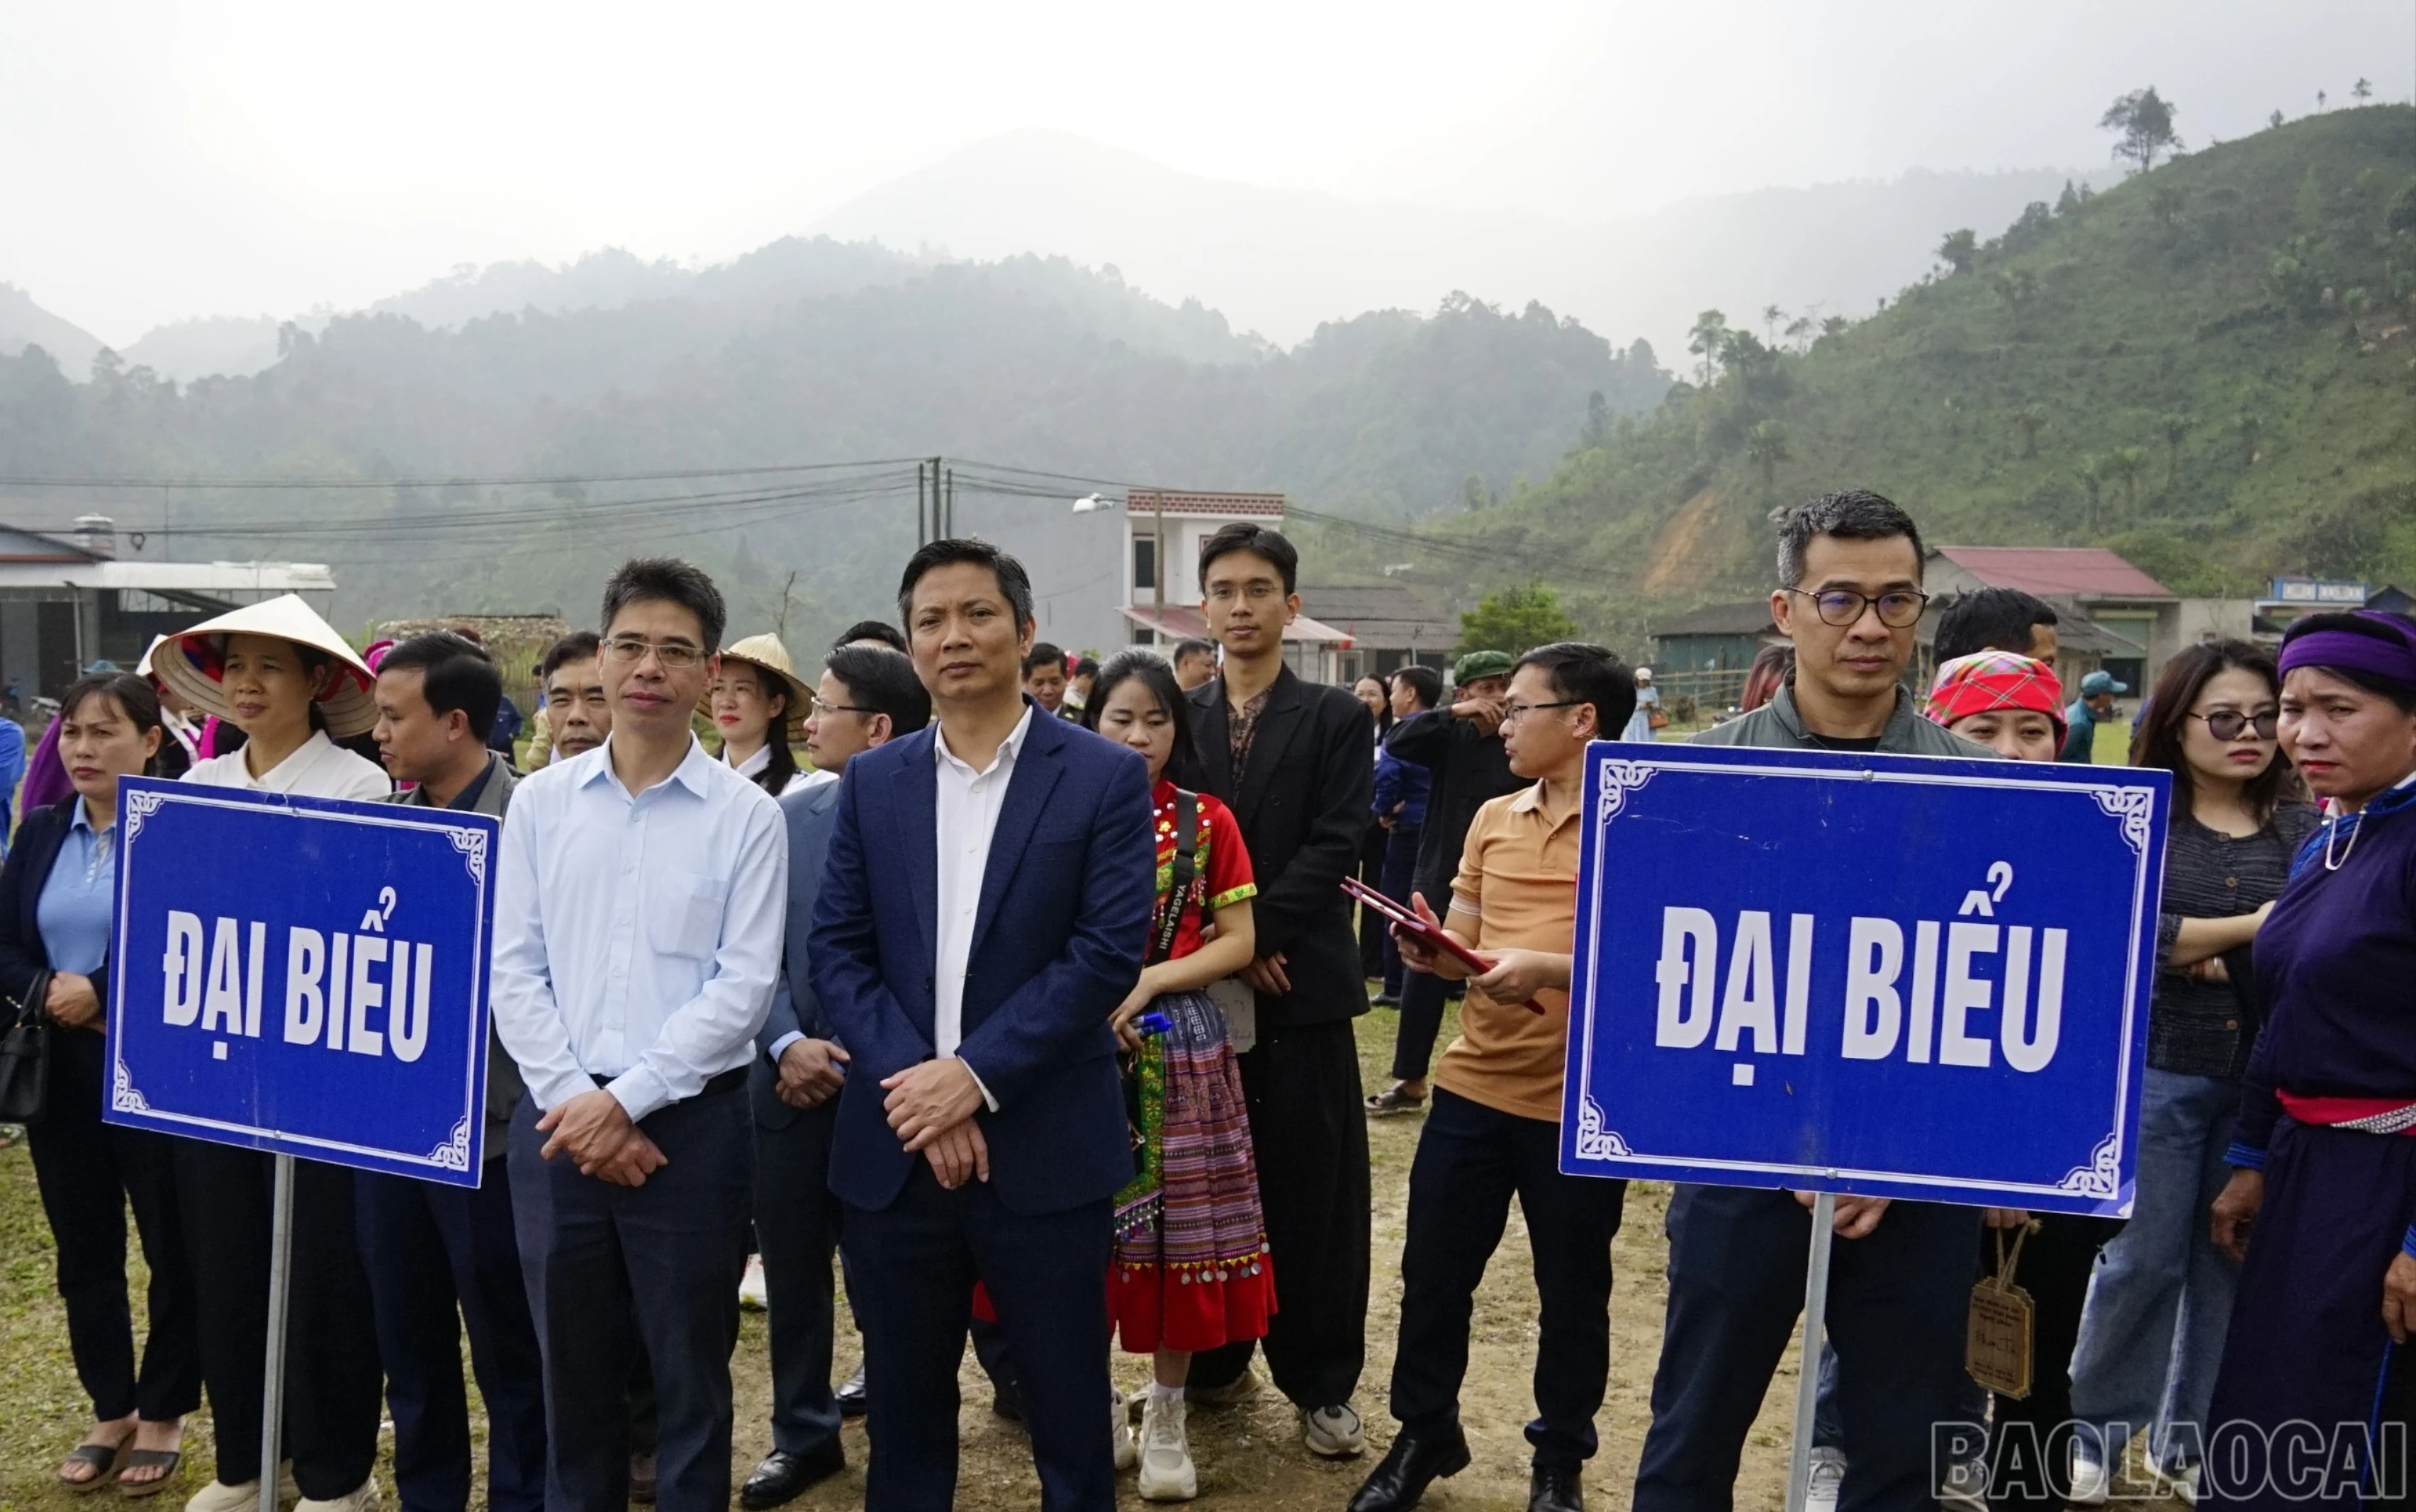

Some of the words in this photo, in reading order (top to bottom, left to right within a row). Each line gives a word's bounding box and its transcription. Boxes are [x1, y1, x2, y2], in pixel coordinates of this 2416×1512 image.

[163, 910, 266, 1061] ĐẠI
[284, 886, 432, 1062] BIỂU
[1158, 884, 1187, 949] YAGELAISHI
[1656, 906, 1814, 1086] ĐẠI
[1841, 861, 2067, 1073] BIỂU
